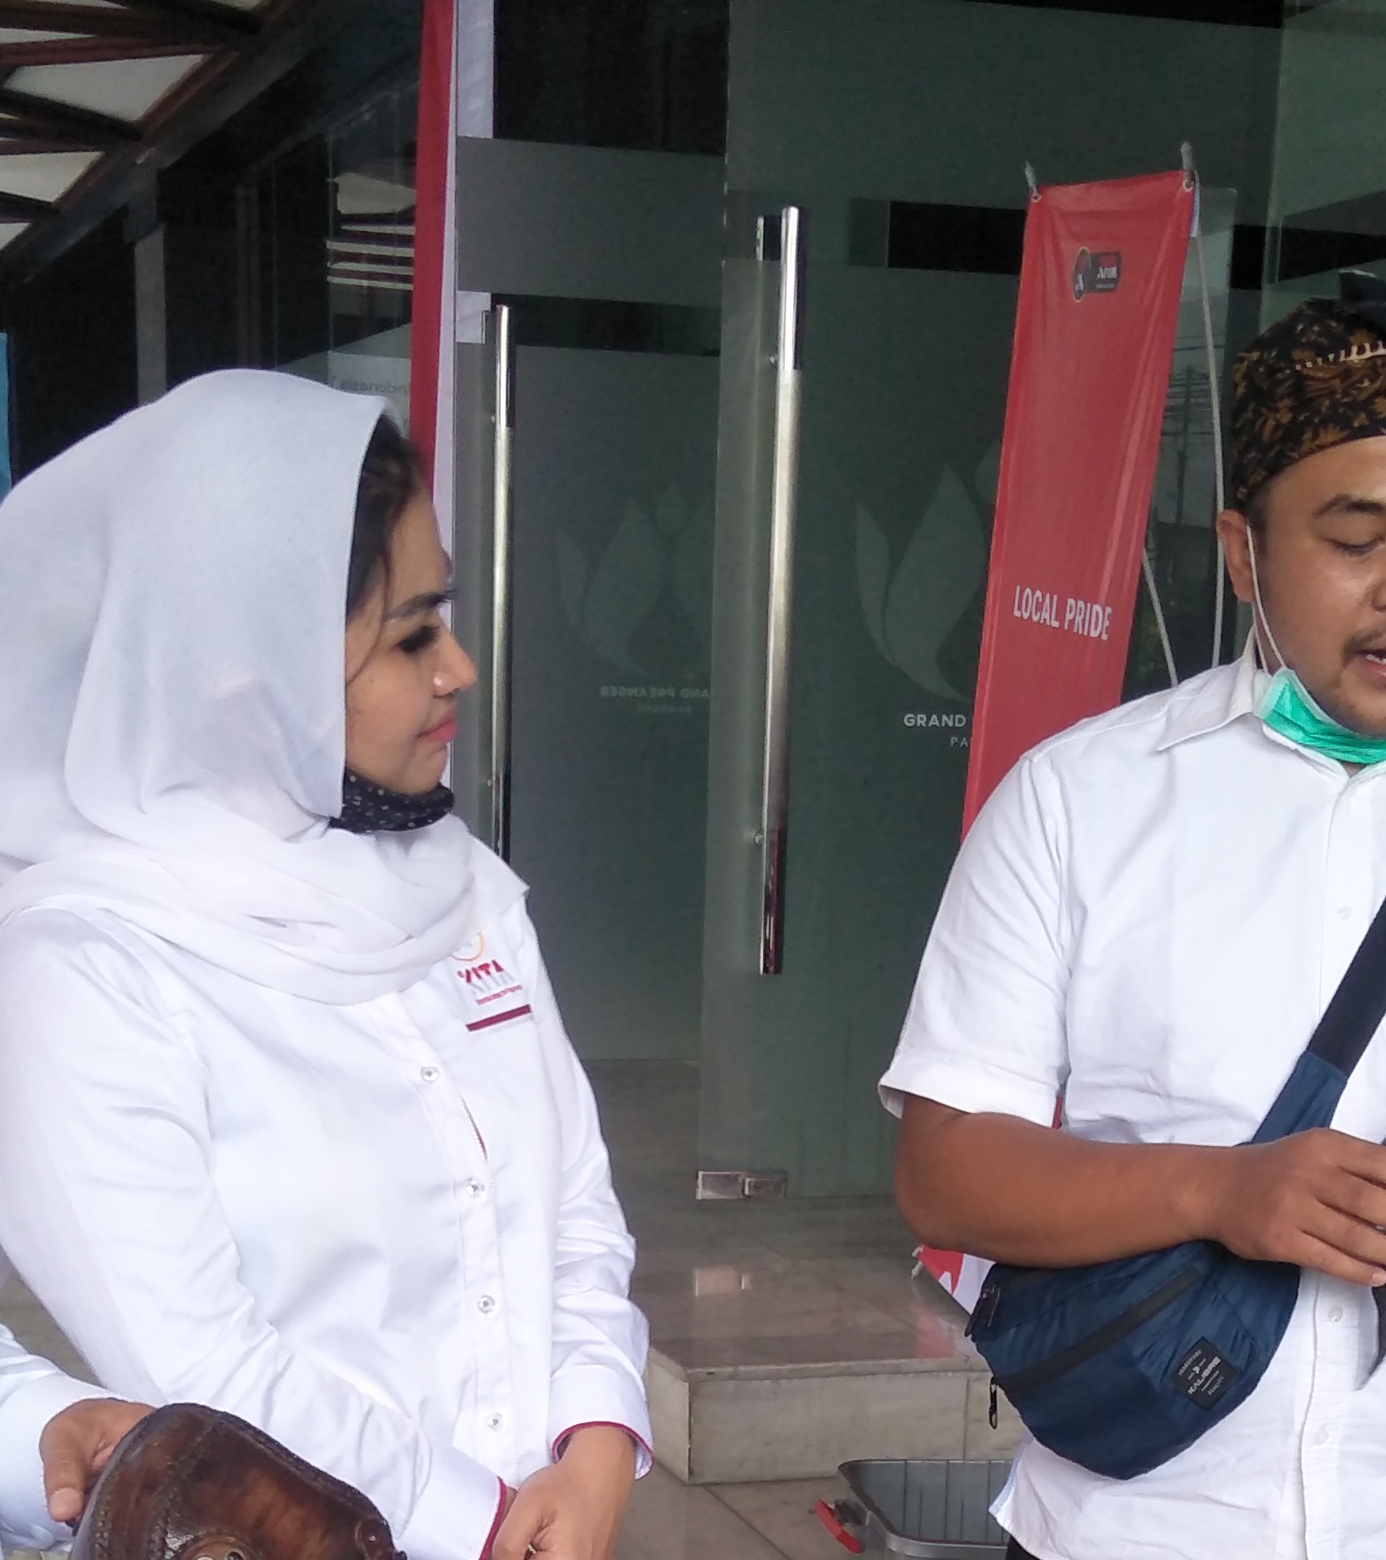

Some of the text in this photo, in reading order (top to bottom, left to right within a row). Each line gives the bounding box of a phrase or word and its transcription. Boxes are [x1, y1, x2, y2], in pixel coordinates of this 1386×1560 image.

[1013, 585, 1111, 641] LOCAL PRIDE
[903, 713, 967, 728] GRAND
